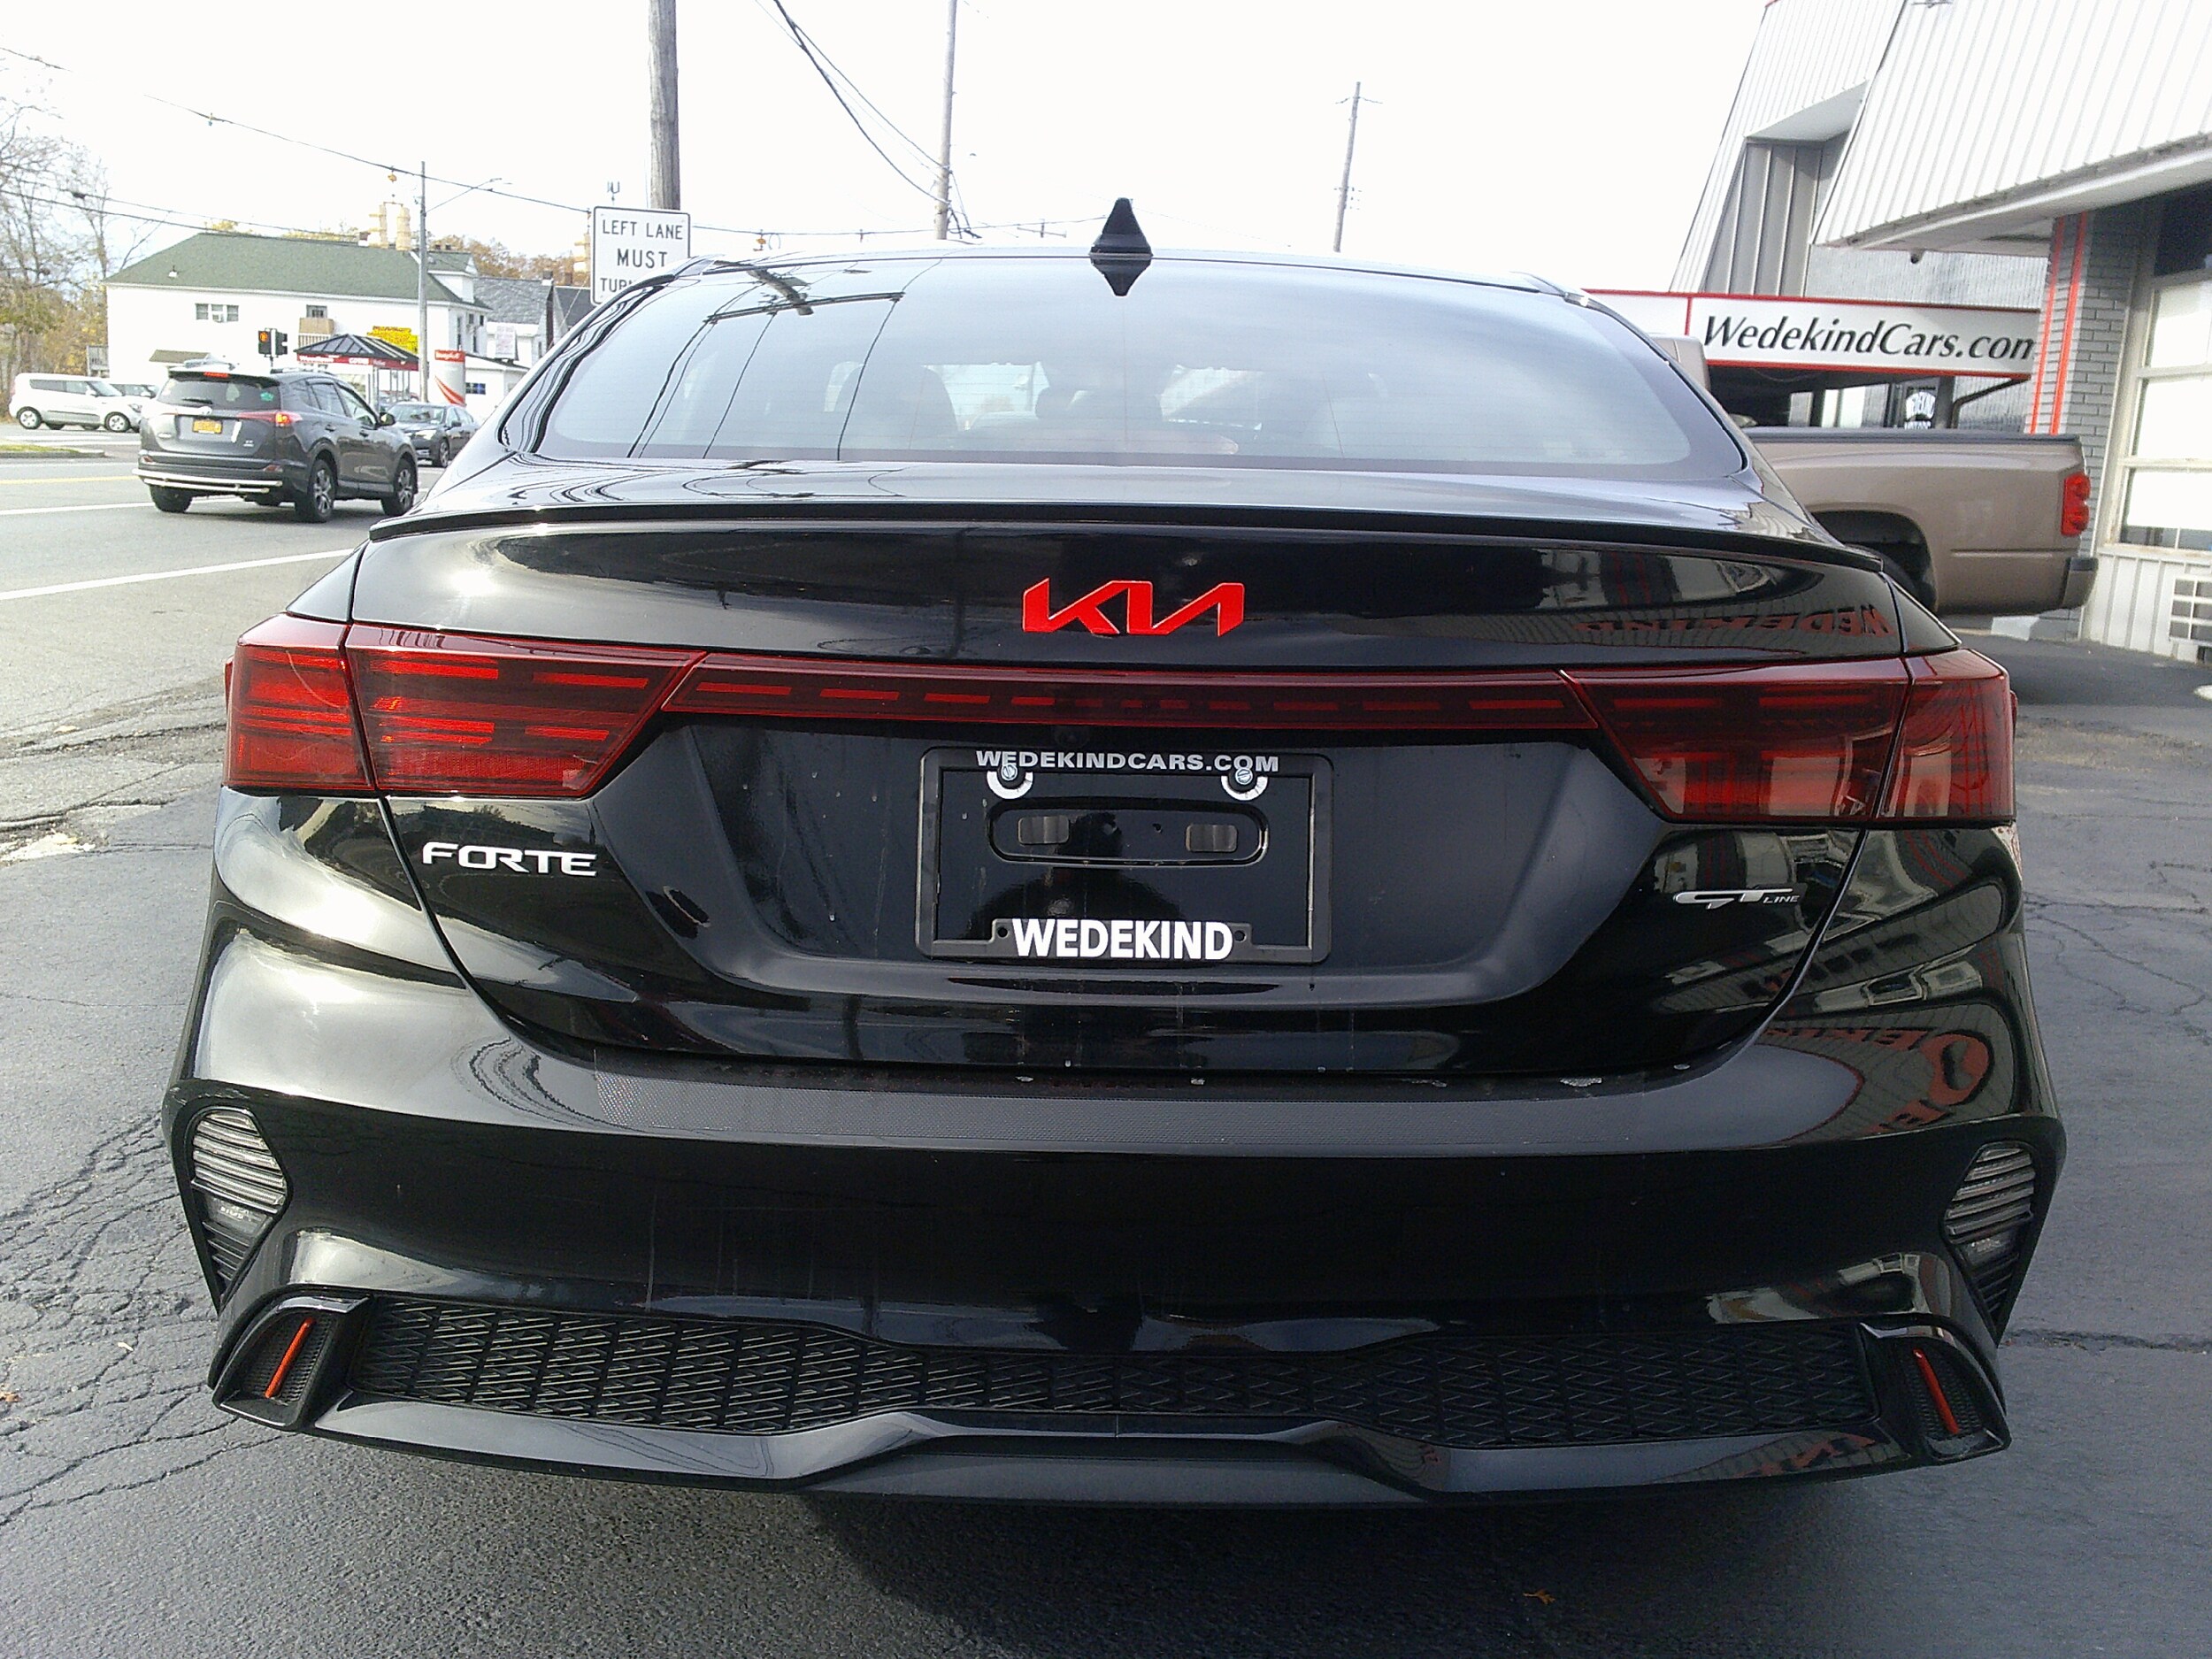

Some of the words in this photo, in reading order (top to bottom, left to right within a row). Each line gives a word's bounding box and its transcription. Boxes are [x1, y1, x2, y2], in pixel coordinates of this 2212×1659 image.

[603, 219, 637, 235] LEFT
[646, 223, 683, 240] LANE
[617, 248, 667, 268] MUST
[600, 278, 633, 293] TUR
[1022, 578, 1245, 637] KIA
[976, 750, 1279, 772] WEDEKINDCARS.COM
[422, 841, 597, 877] FORTE
[1763, 895, 1801, 904] LINE
[1011, 918, 1234, 961] WEDEKIND
